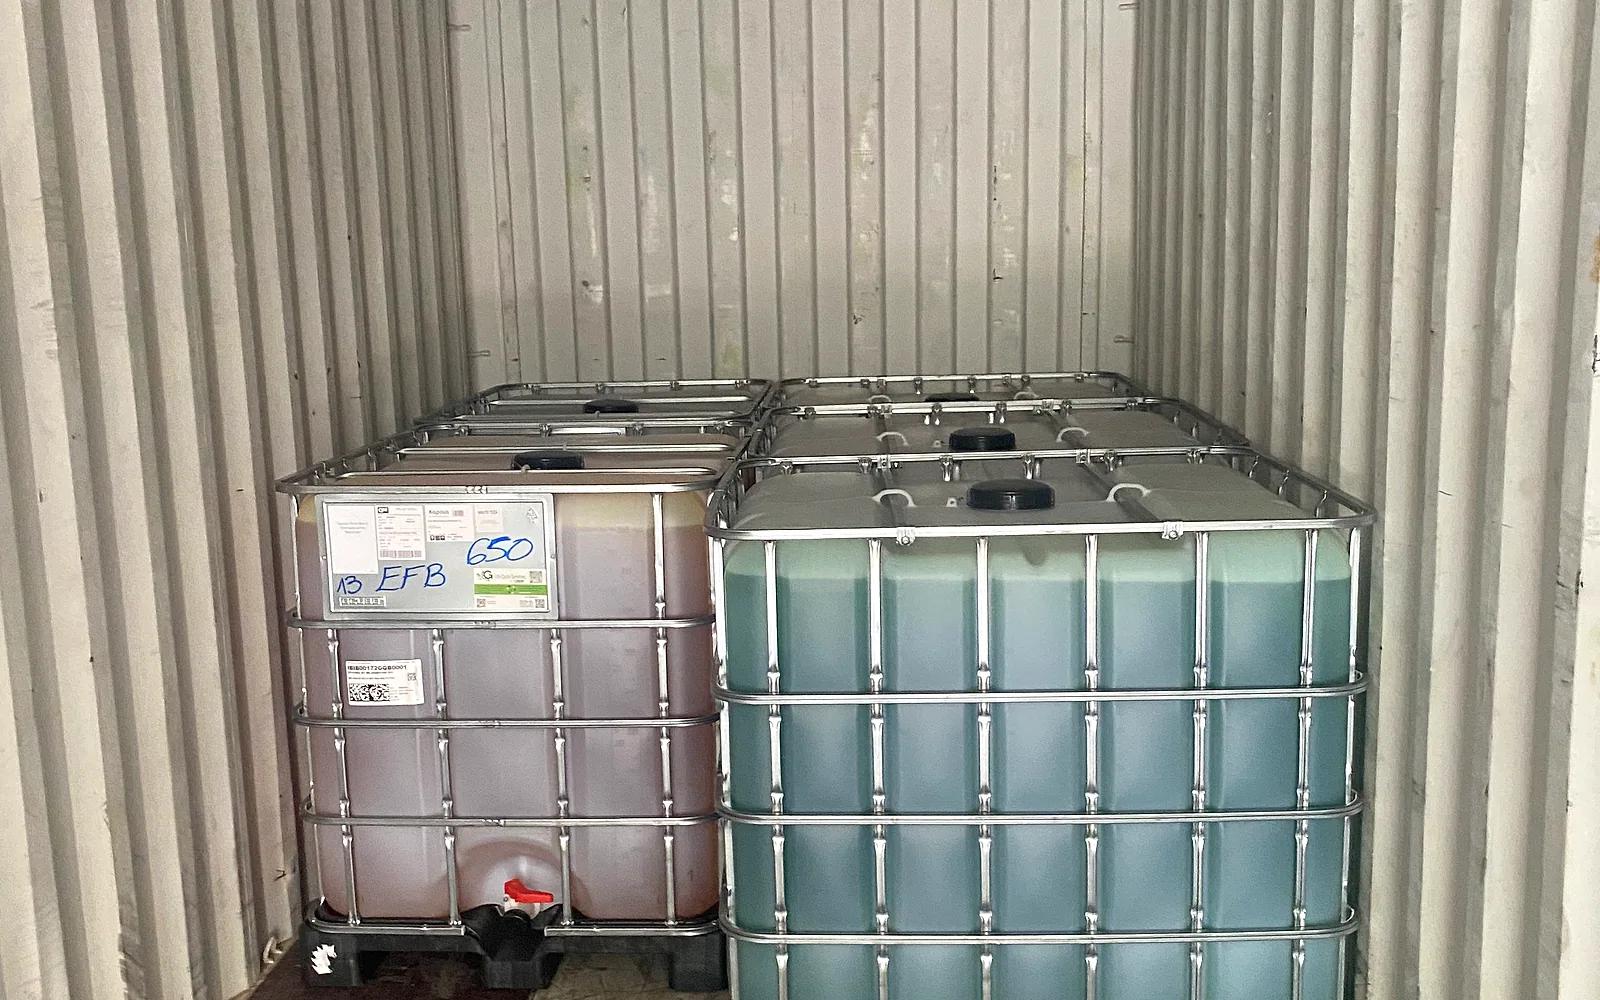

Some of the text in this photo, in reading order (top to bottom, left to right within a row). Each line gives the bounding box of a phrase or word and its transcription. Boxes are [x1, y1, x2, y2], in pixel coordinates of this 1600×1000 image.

[466, 536, 534, 565] 650
[337, 576, 363, 595] 13
[375, 563, 446, 592] EFB
